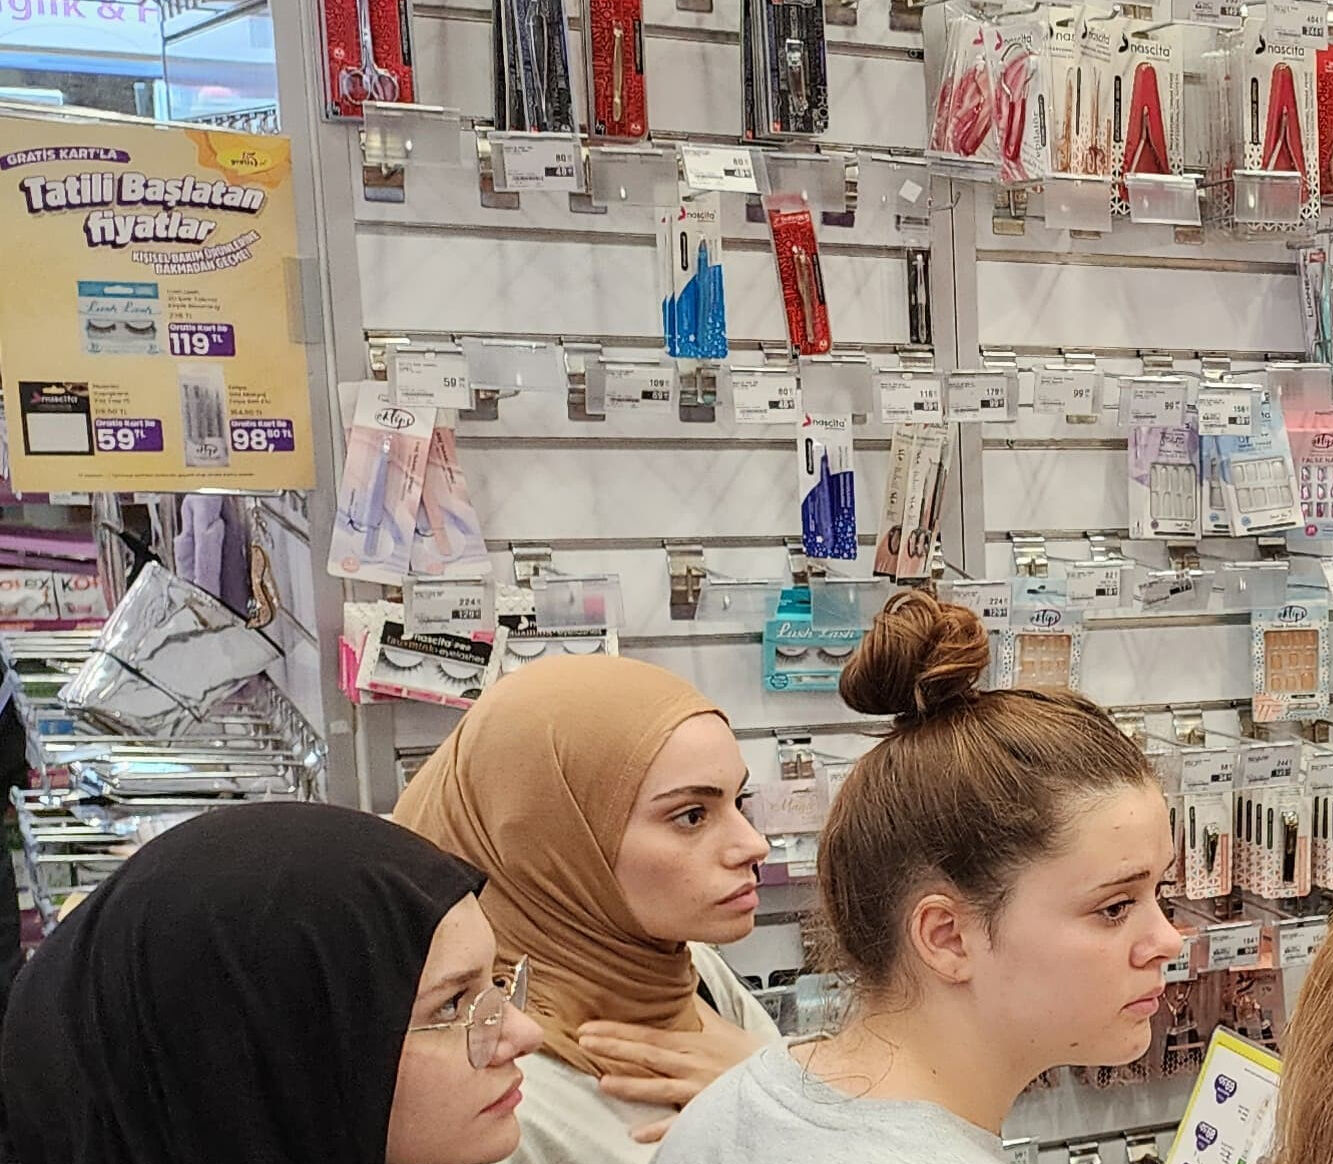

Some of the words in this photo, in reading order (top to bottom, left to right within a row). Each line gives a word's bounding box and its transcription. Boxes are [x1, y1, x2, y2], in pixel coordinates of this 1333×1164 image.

[1130, 41, 1171, 57] nascita
[6, 149, 56, 166] GRATİS
[59, 148, 117, 161] KART'LA
[22, 173, 113, 212] Tatili
[121, 176, 266, 212] Başlatan
[85, 209, 216, 248] fiyatlar
[170, 333, 209, 355] 119
[212, 333, 223, 344] TL
[281, 428, 292, 438] TL
[812, 419, 847, 429] nascita
[98, 430, 134, 450] 59
[134, 427, 146, 438] TL
